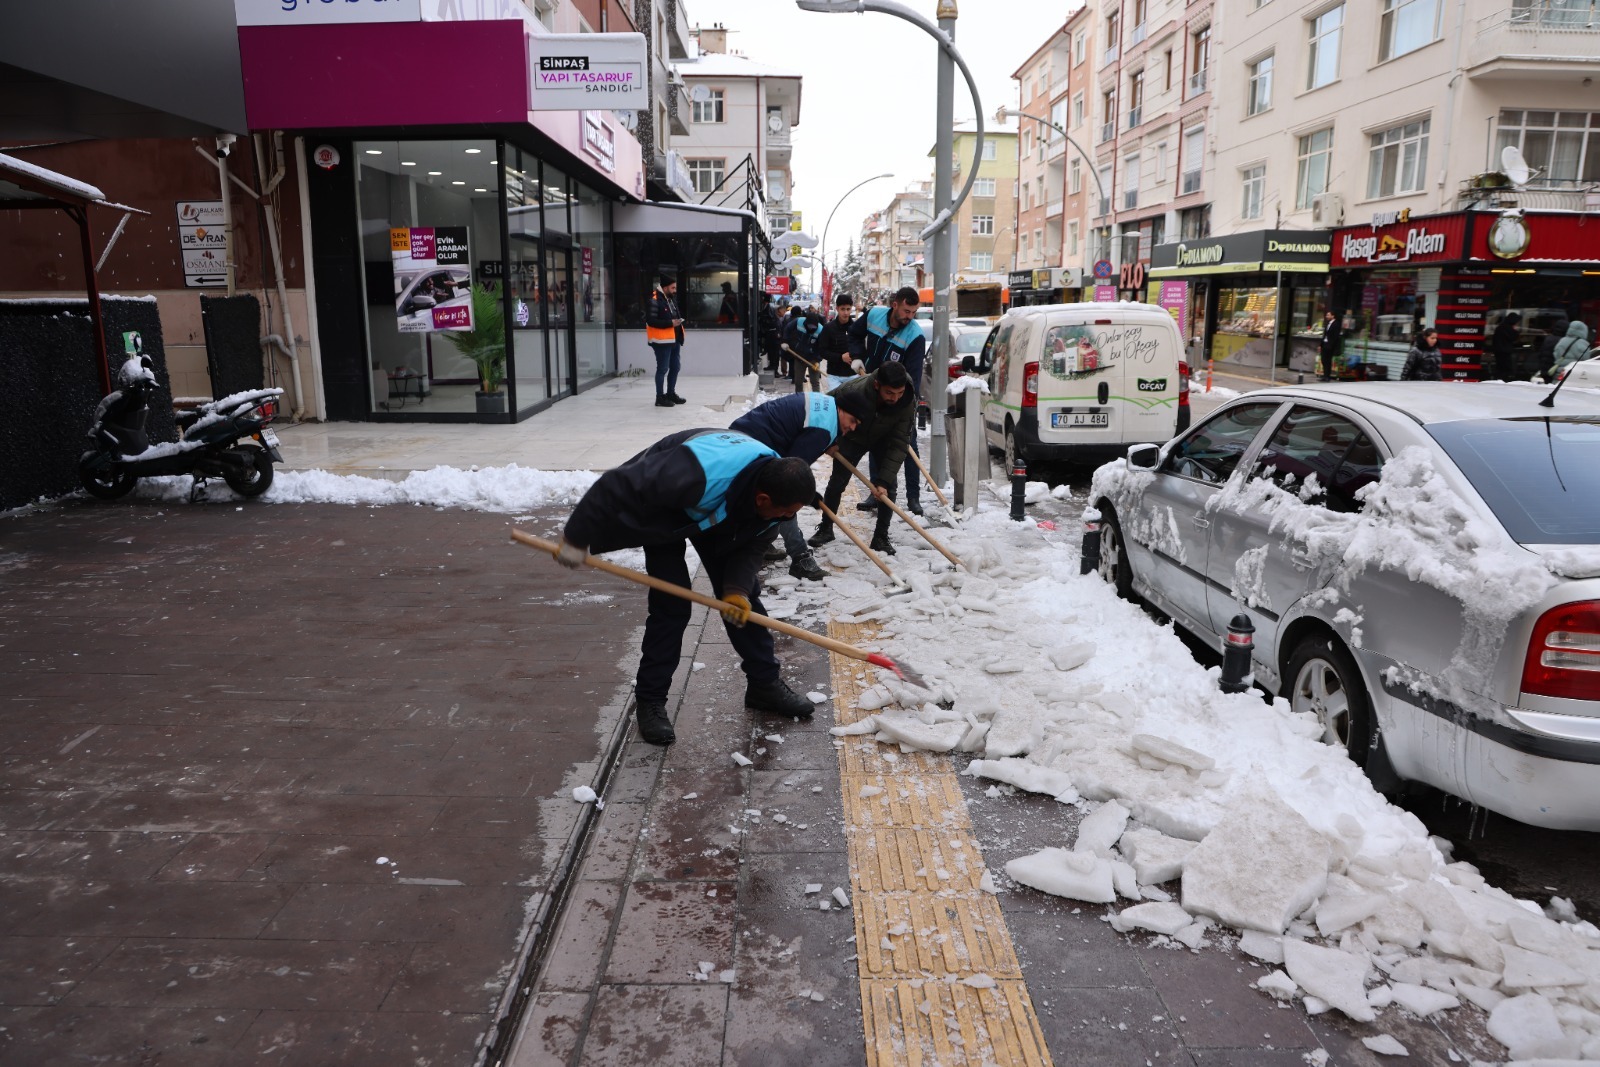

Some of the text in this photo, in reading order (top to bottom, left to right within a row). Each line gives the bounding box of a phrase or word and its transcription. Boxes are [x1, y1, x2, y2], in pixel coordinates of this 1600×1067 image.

[543, 57, 585, 70] SİNPAŞ
[541, 73, 570, 83] YAPI
[437, 236, 454, 244] EVİN
[1342, 227, 1445, 262] Kasap Adem
[1119, 263, 1144, 289] FLO
[1139, 382, 1165, 392] OFÇAY
[1057, 415, 1107, 424] 70 AJ 484
